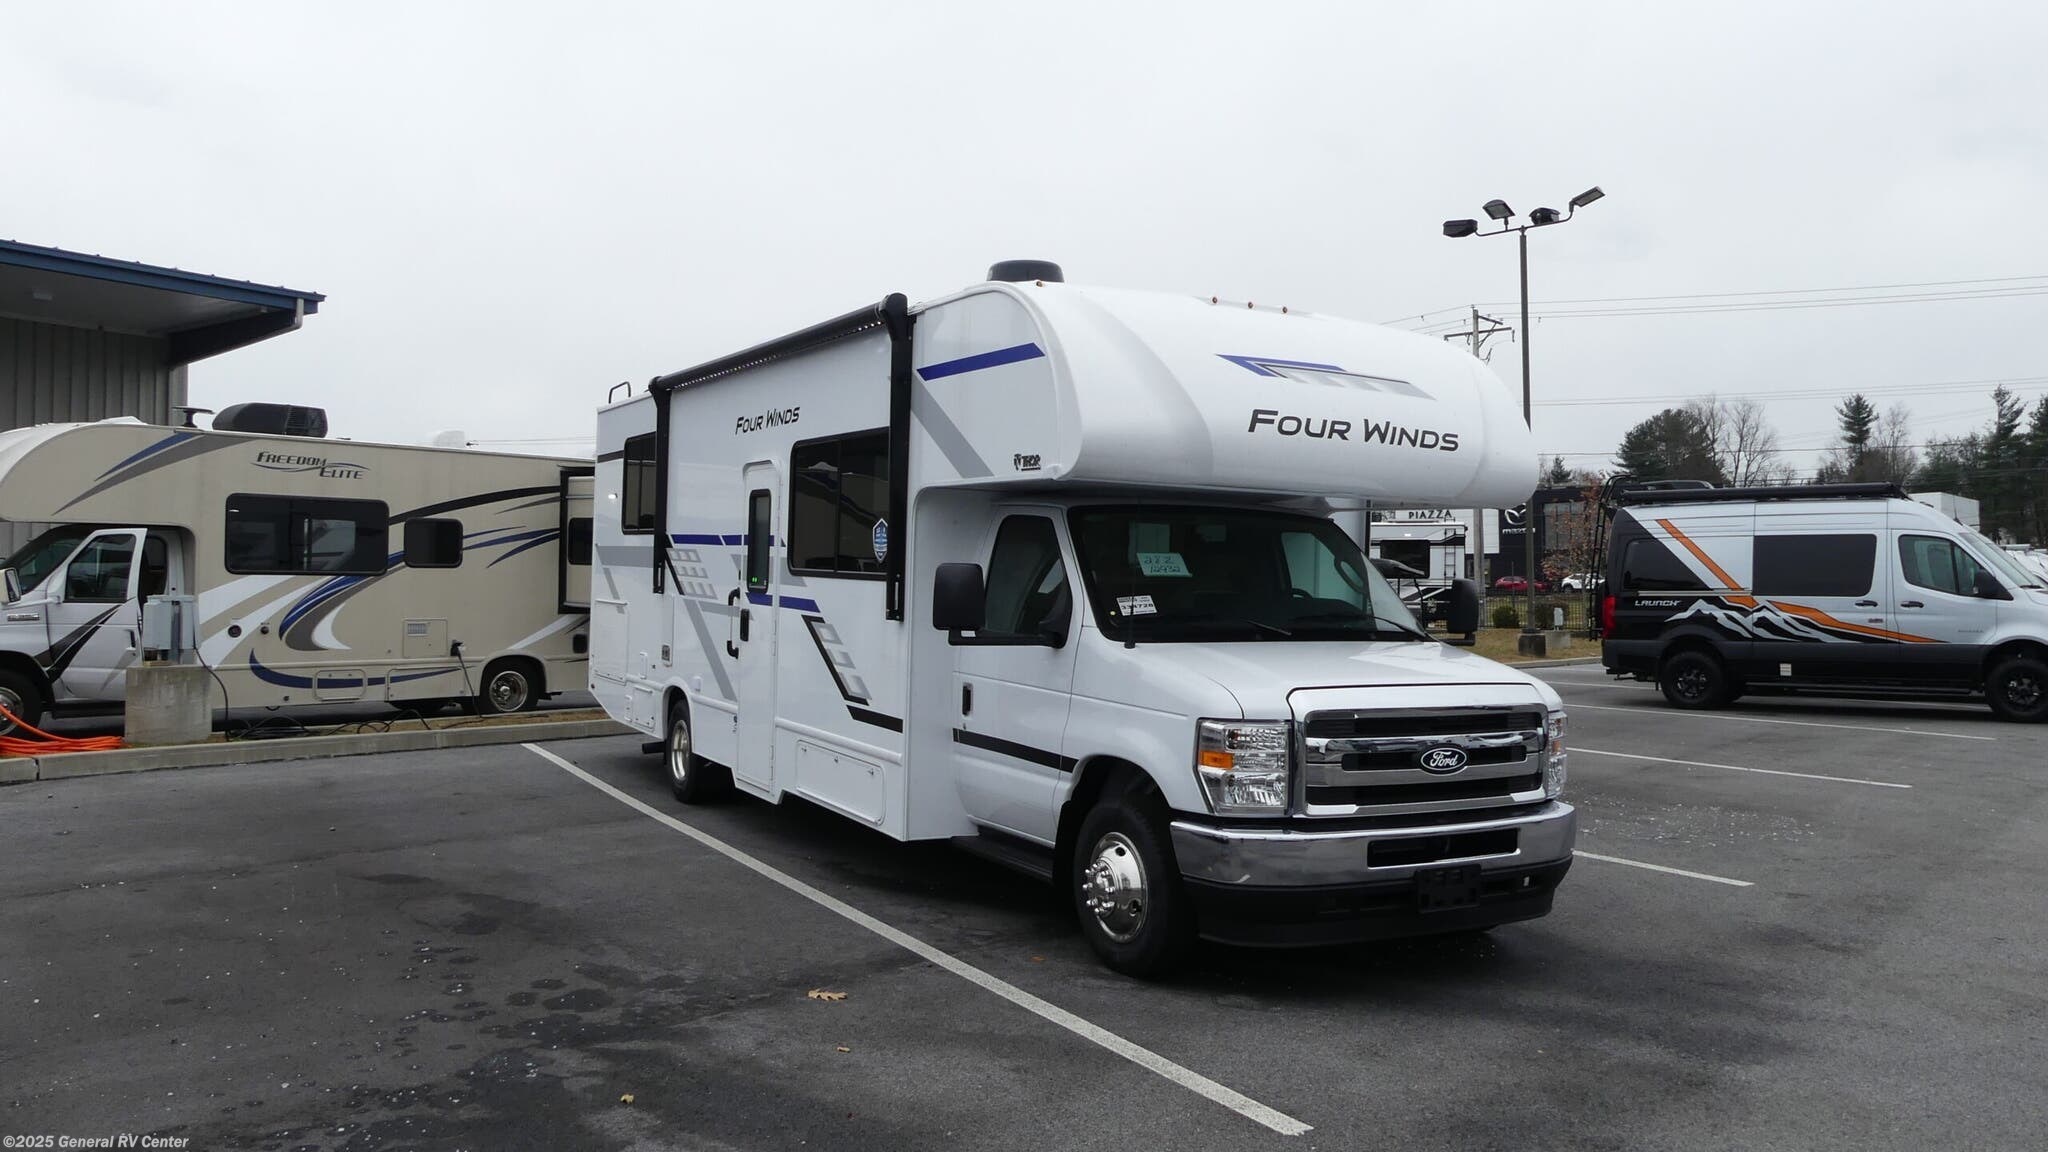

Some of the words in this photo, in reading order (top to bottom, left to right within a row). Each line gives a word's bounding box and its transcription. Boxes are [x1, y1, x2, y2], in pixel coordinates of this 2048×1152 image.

[735, 416, 764, 435] FOUR
[766, 407, 800, 428] WINDS
[1248, 409, 1351, 440] FOUR
[1364, 419, 1458, 451] WINDS
[256, 451, 327, 467] FREEDOM
[320, 467, 363, 479] ELITE
[1408, 509, 1453, 519] PIAZZA
[1430, 751, 1459, 767] Ford
